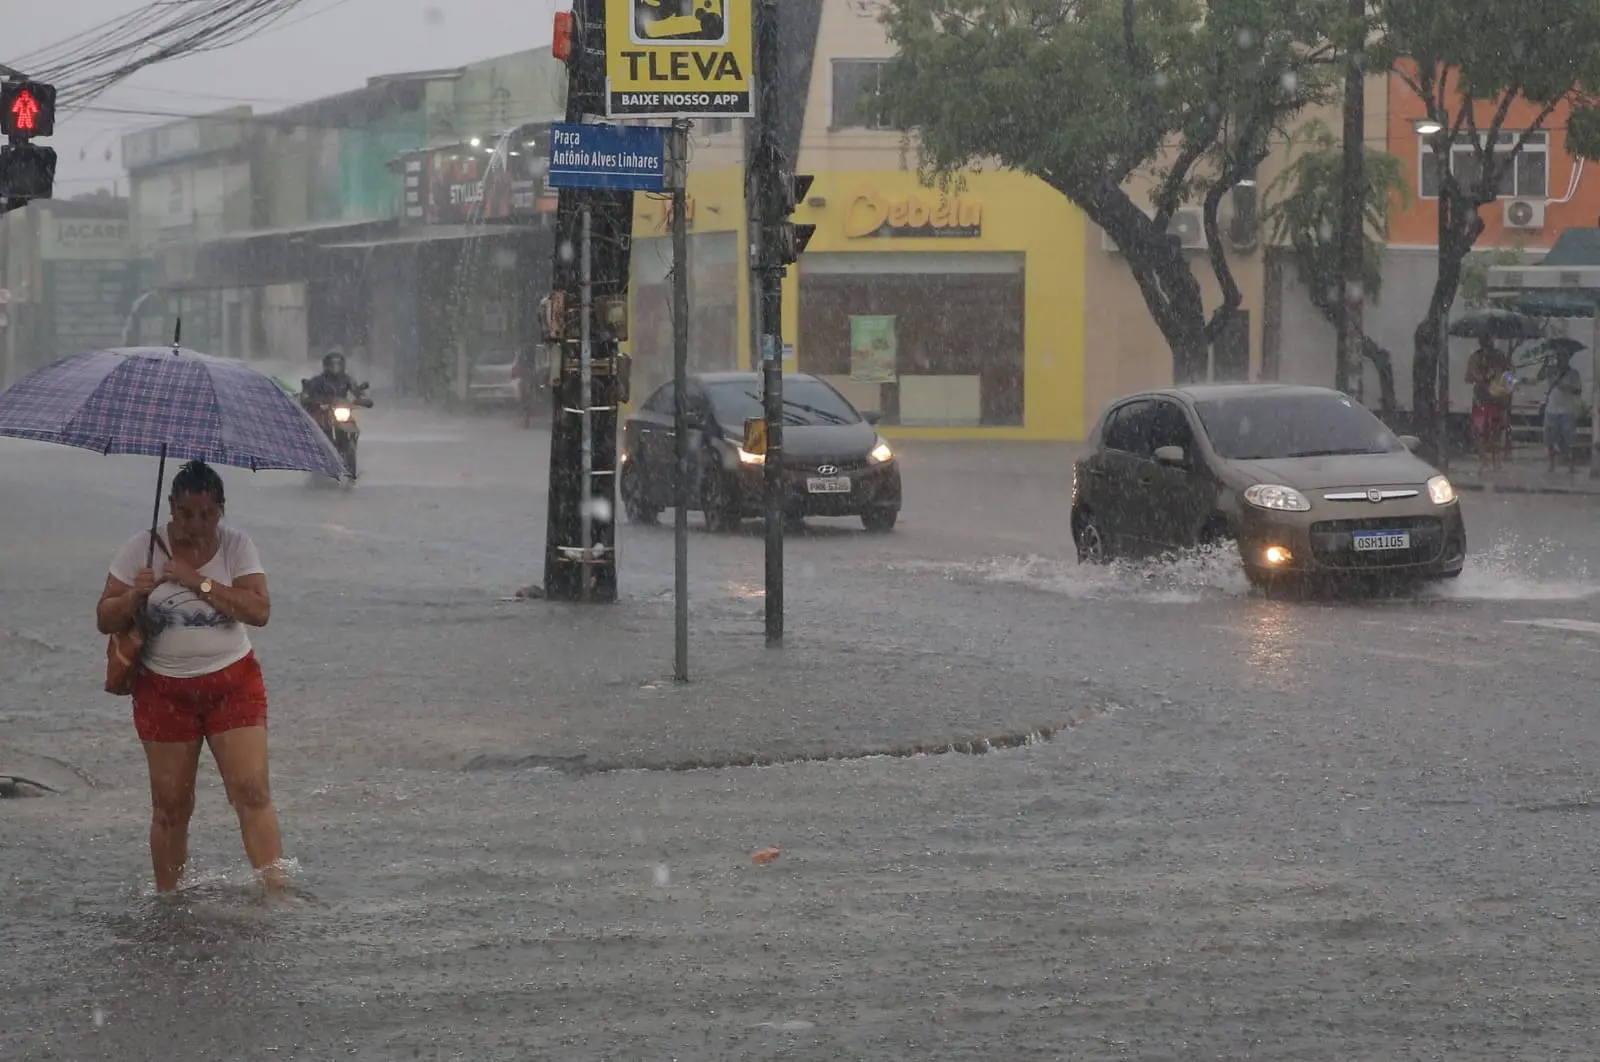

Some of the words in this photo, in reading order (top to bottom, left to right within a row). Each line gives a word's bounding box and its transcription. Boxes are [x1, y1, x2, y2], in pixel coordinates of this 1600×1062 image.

[620, 51, 743, 81] TLEVA
[621, 94, 660, 106] BAIXE
[663, 94, 709, 106] NOSSO
[713, 94, 739, 105] APP
[554, 129, 580, 148] Praça
[553, 149, 589, 166] Antônio
[591, 150, 616, 168] Alves
[618, 151, 659, 169] Linhares
